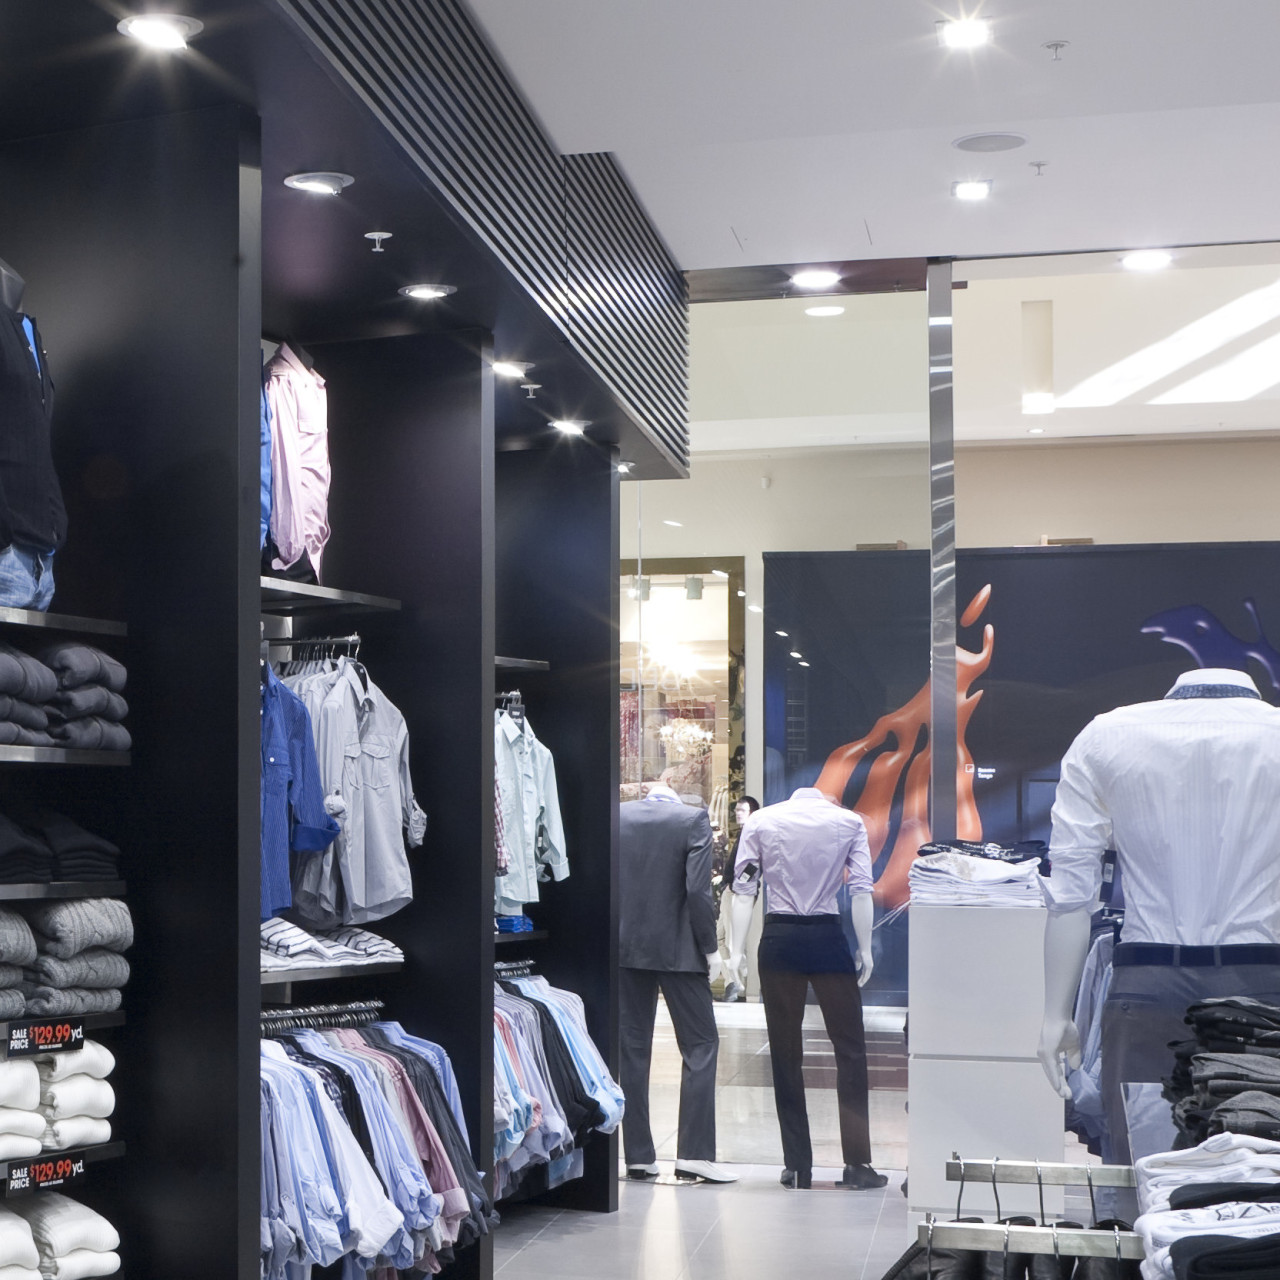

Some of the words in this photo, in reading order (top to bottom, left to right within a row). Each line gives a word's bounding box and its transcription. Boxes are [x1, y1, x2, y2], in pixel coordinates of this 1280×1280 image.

[12, 1028, 27, 1039] SALE
[29, 1024, 70, 1045] $129.99
[71, 1025, 83, 1042] yd.
[10, 1039, 29, 1050] PRICE
[12, 1167, 28, 1179] SALE
[30, 1158, 72, 1182] $129.99
[72, 1160, 84, 1177] yd.
[10, 1178, 29, 1190] PRICE
